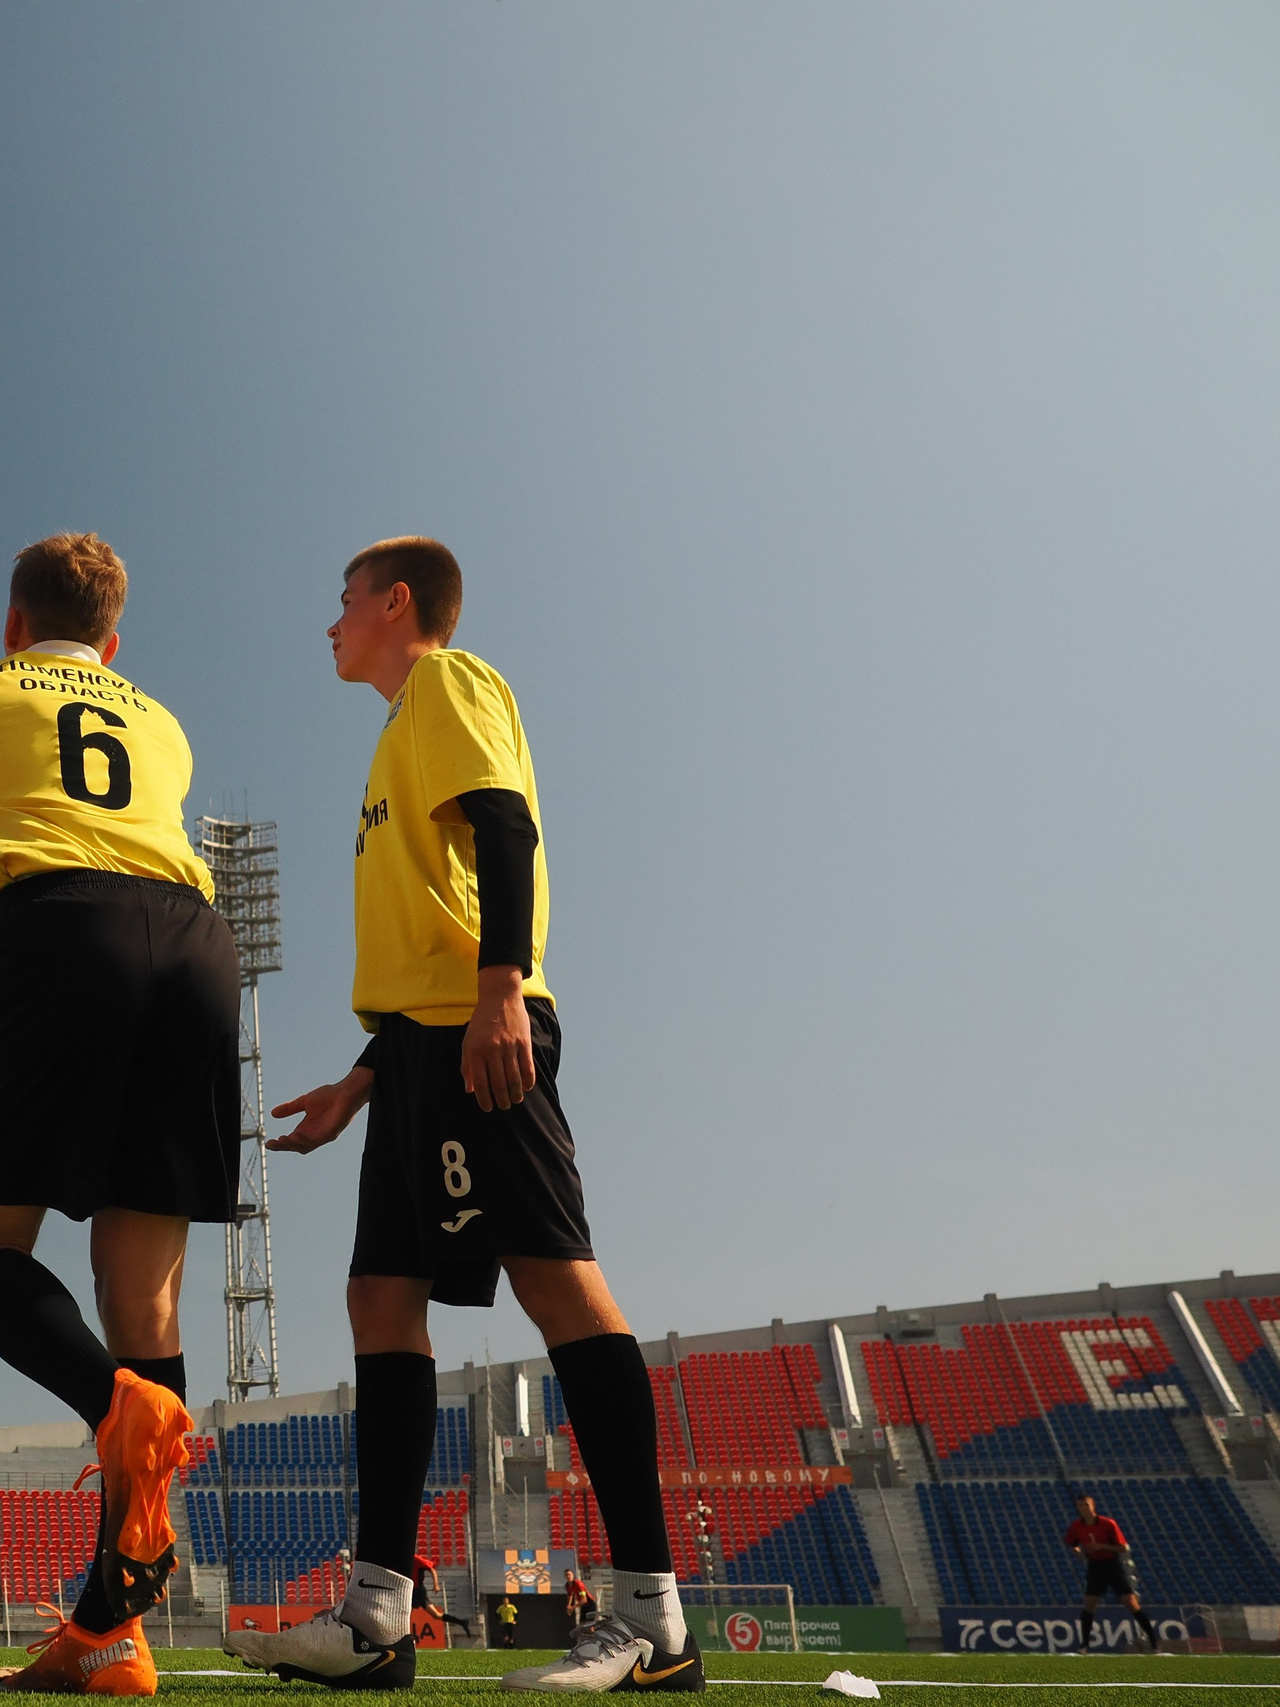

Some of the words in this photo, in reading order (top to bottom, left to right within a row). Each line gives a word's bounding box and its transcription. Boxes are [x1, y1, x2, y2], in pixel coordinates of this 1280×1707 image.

[20, 678, 148, 712] ОБЛАСТЬ
[57, 701, 132, 810] 6
[441, 1140, 472, 1198] 8
[734, 1613, 753, 1645] 5
[766, 1635, 841, 1650] вырчает!
[78, 1637, 139, 1679] PUMA
